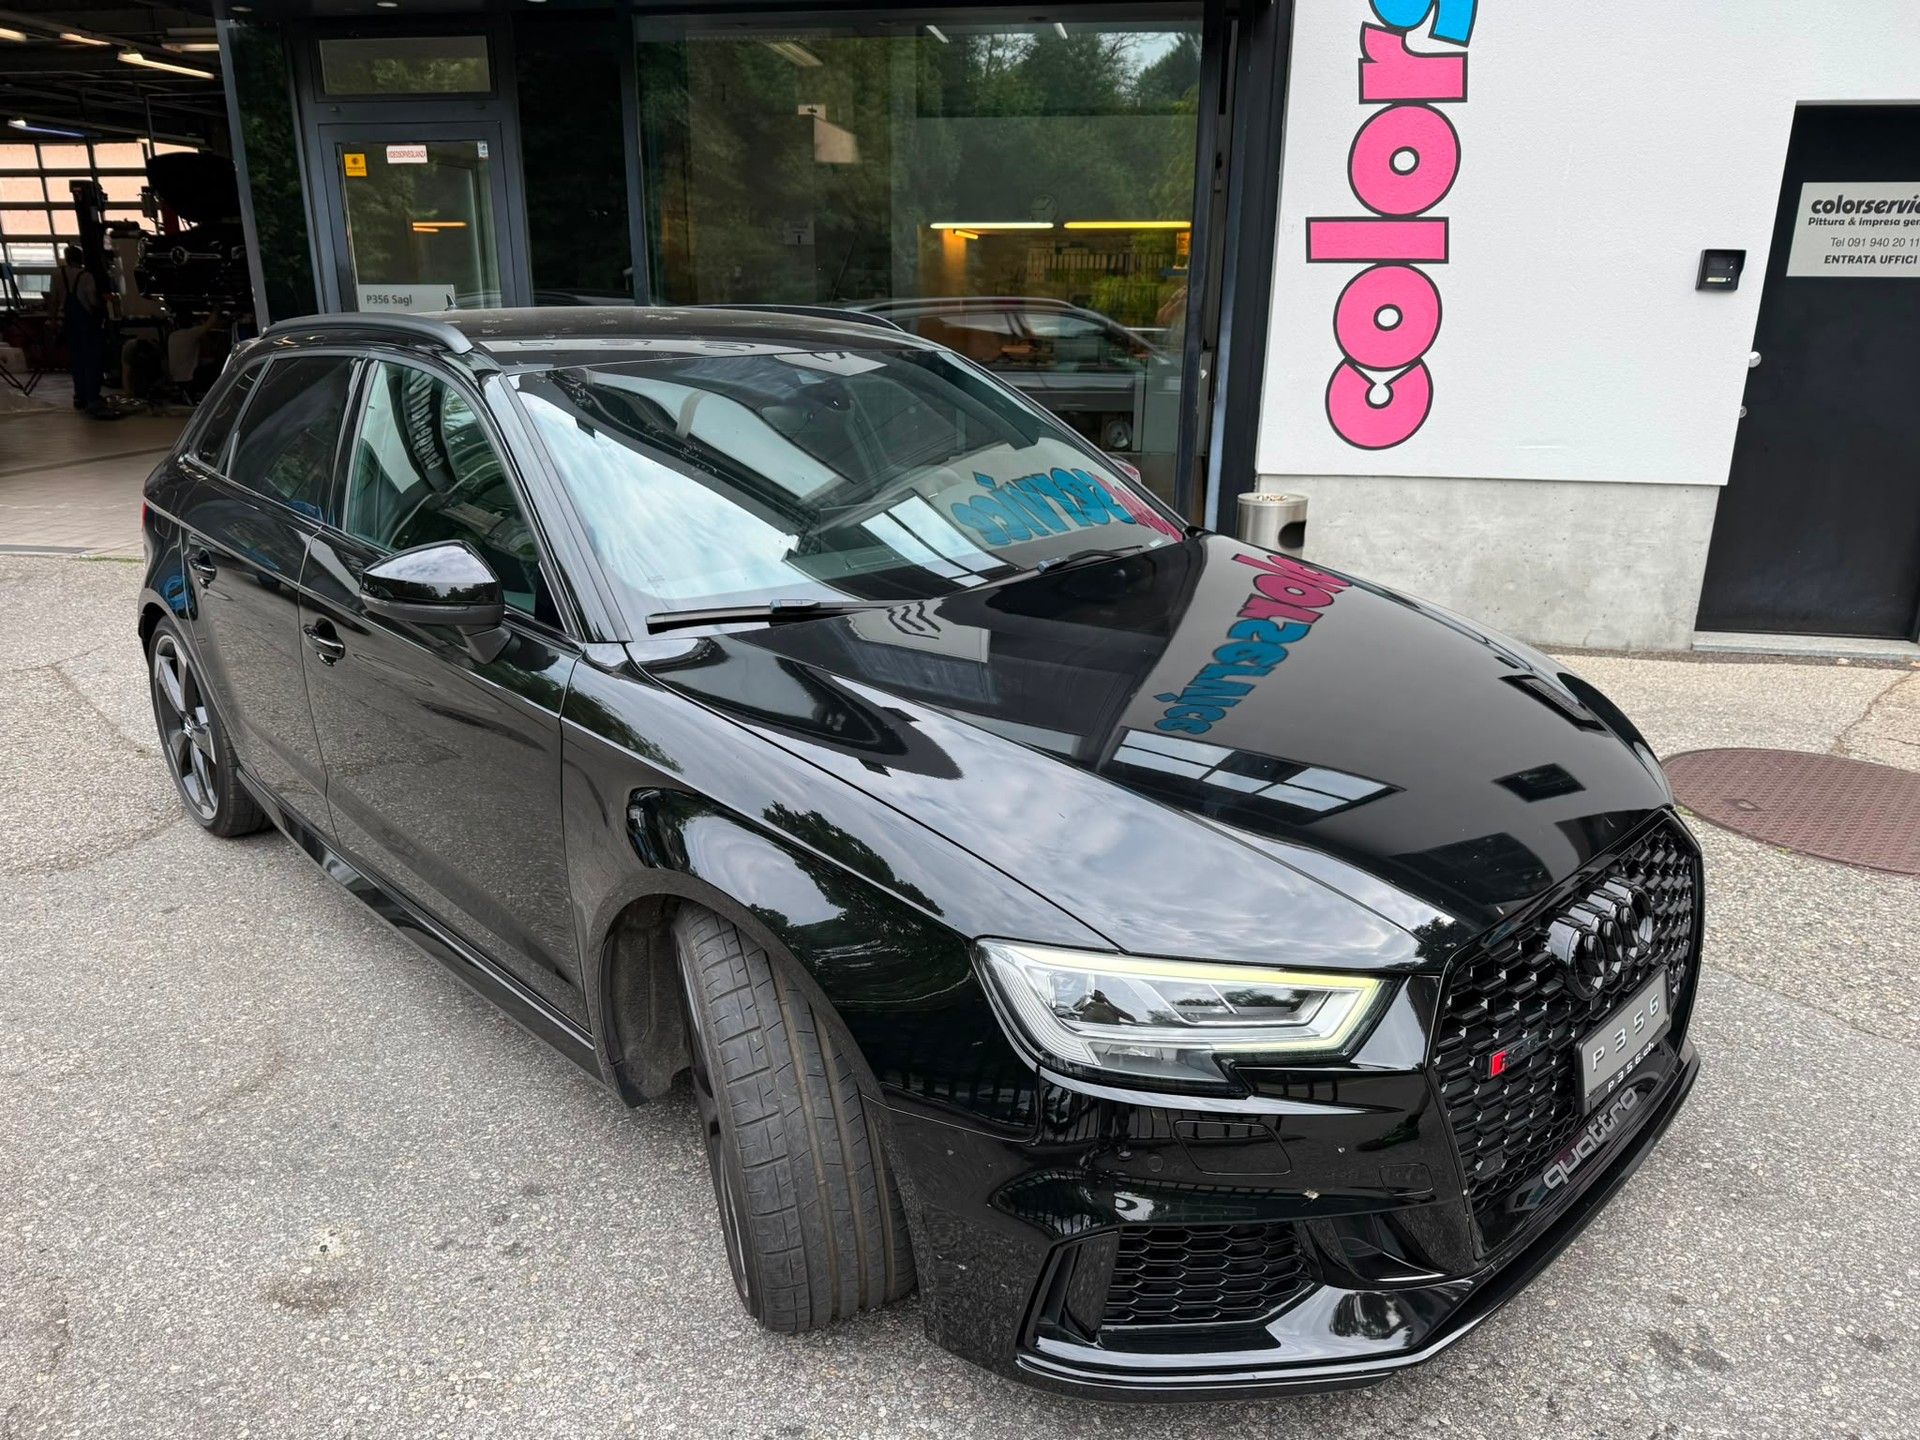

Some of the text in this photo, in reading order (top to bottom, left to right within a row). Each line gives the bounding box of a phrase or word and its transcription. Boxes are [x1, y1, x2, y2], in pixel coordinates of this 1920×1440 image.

[1808, 217, 1846, 226] Pittura
[1848, 217, 1857, 226] &
[1859, 217, 1901, 227] impresa
[1831, 237, 1920, 247] Tel 091 940 20 11
[1824, 255, 1918, 264] ENTRATA UFFICI
[366, 294, 413, 306] P356 Sagl
[1543, 1087, 1638, 1190] quattro
